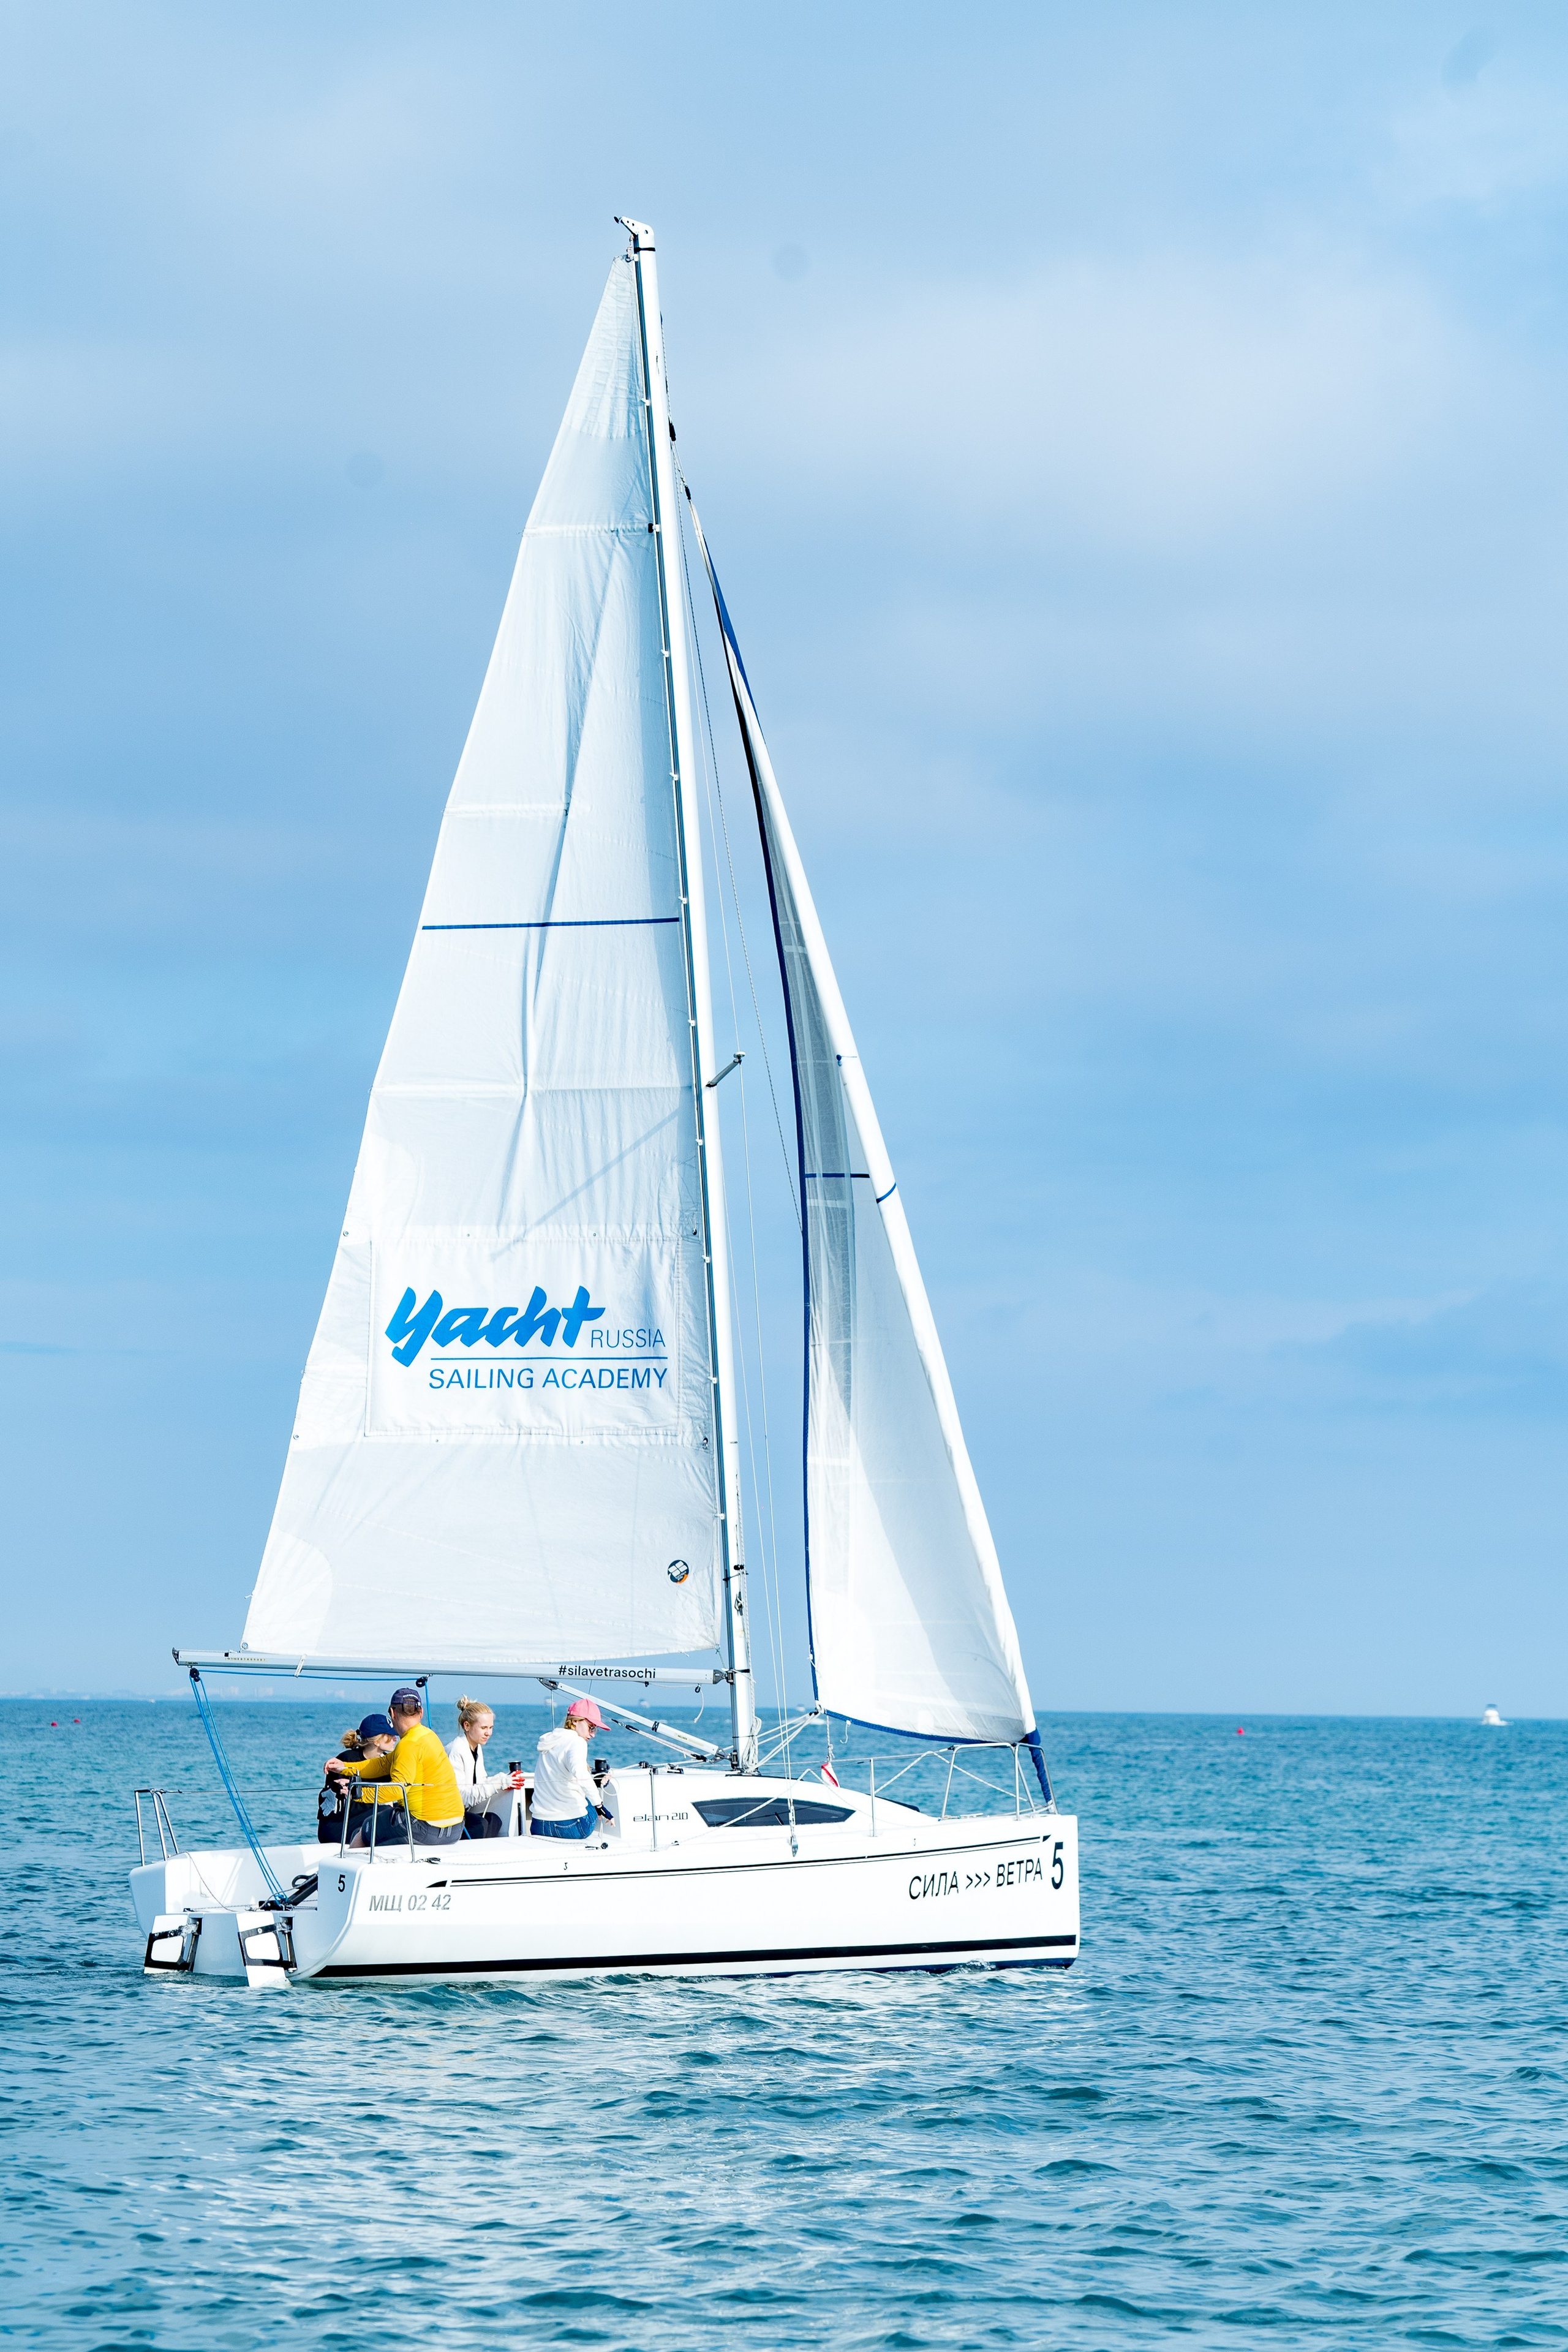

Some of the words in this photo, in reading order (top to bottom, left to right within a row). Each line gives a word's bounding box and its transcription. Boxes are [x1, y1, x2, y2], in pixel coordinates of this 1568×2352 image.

[591, 1328, 666, 1348] RUSSIA
[429, 1368, 534, 1389] SAILING
[542, 1367, 668, 1389] ACADEMY
[559, 1665, 656, 1679] #silavetrasochi
[633, 1814, 669, 1822] elan
[671, 1812, 688, 1820] 210
[1051, 1841, 1064, 1890] 5
[337, 1874, 346, 1893] 5
[909, 1871, 959, 1900] СИЛА
[996, 1857, 1043, 1888] ВЕТРА
[408, 1895, 428, 1911] 02
[432, 1894, 451, 1910] 42
